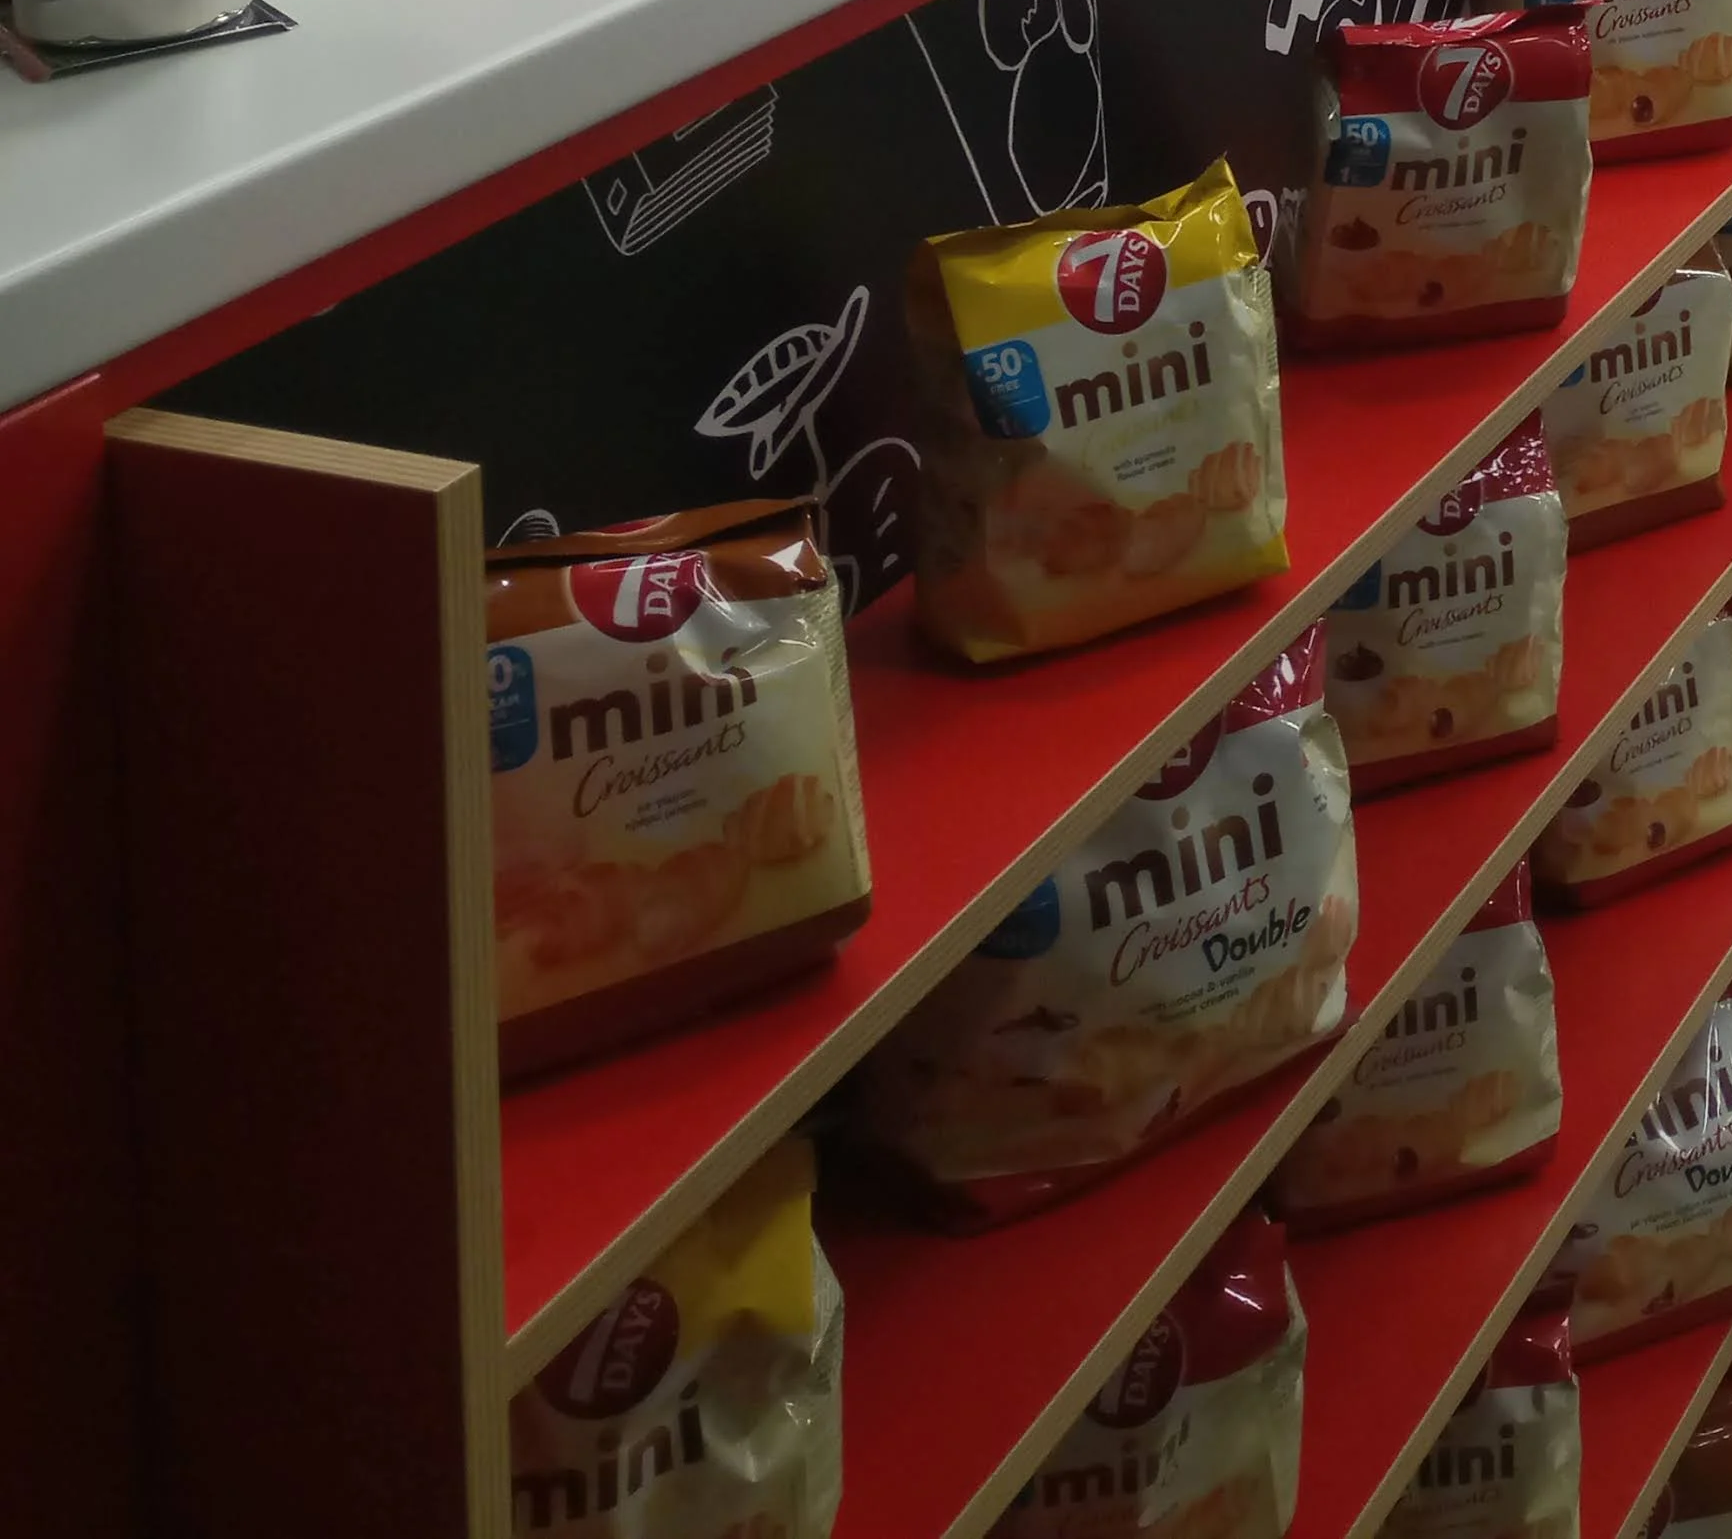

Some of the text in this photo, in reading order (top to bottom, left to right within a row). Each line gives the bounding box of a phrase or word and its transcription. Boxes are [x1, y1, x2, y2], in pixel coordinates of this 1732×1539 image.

[1428, 45, 1503, 121] 7 DAYS
[1391, 129, 1529, 193] mini
[1394, 181, 1508, 227] Croissants
[1074, 235, 1150, 321] 7 DAYS
[1055, 321, 1211, 429] mini
[1589, 310, 1695, 383] mini
[1600, 362, 1686, 415] Croissants
[1386, 532, 1515, 606] mini
[1400, 591, 1505, 646] Croissants
[573, 719, 746, 818] Croissants
[1609, 714, 1693, 775] Croissants
[1087, 773, 1287, 932] mini
[1112, 873, 1271, 986] Croissants
[1202, 898, 1312, 972] Double
